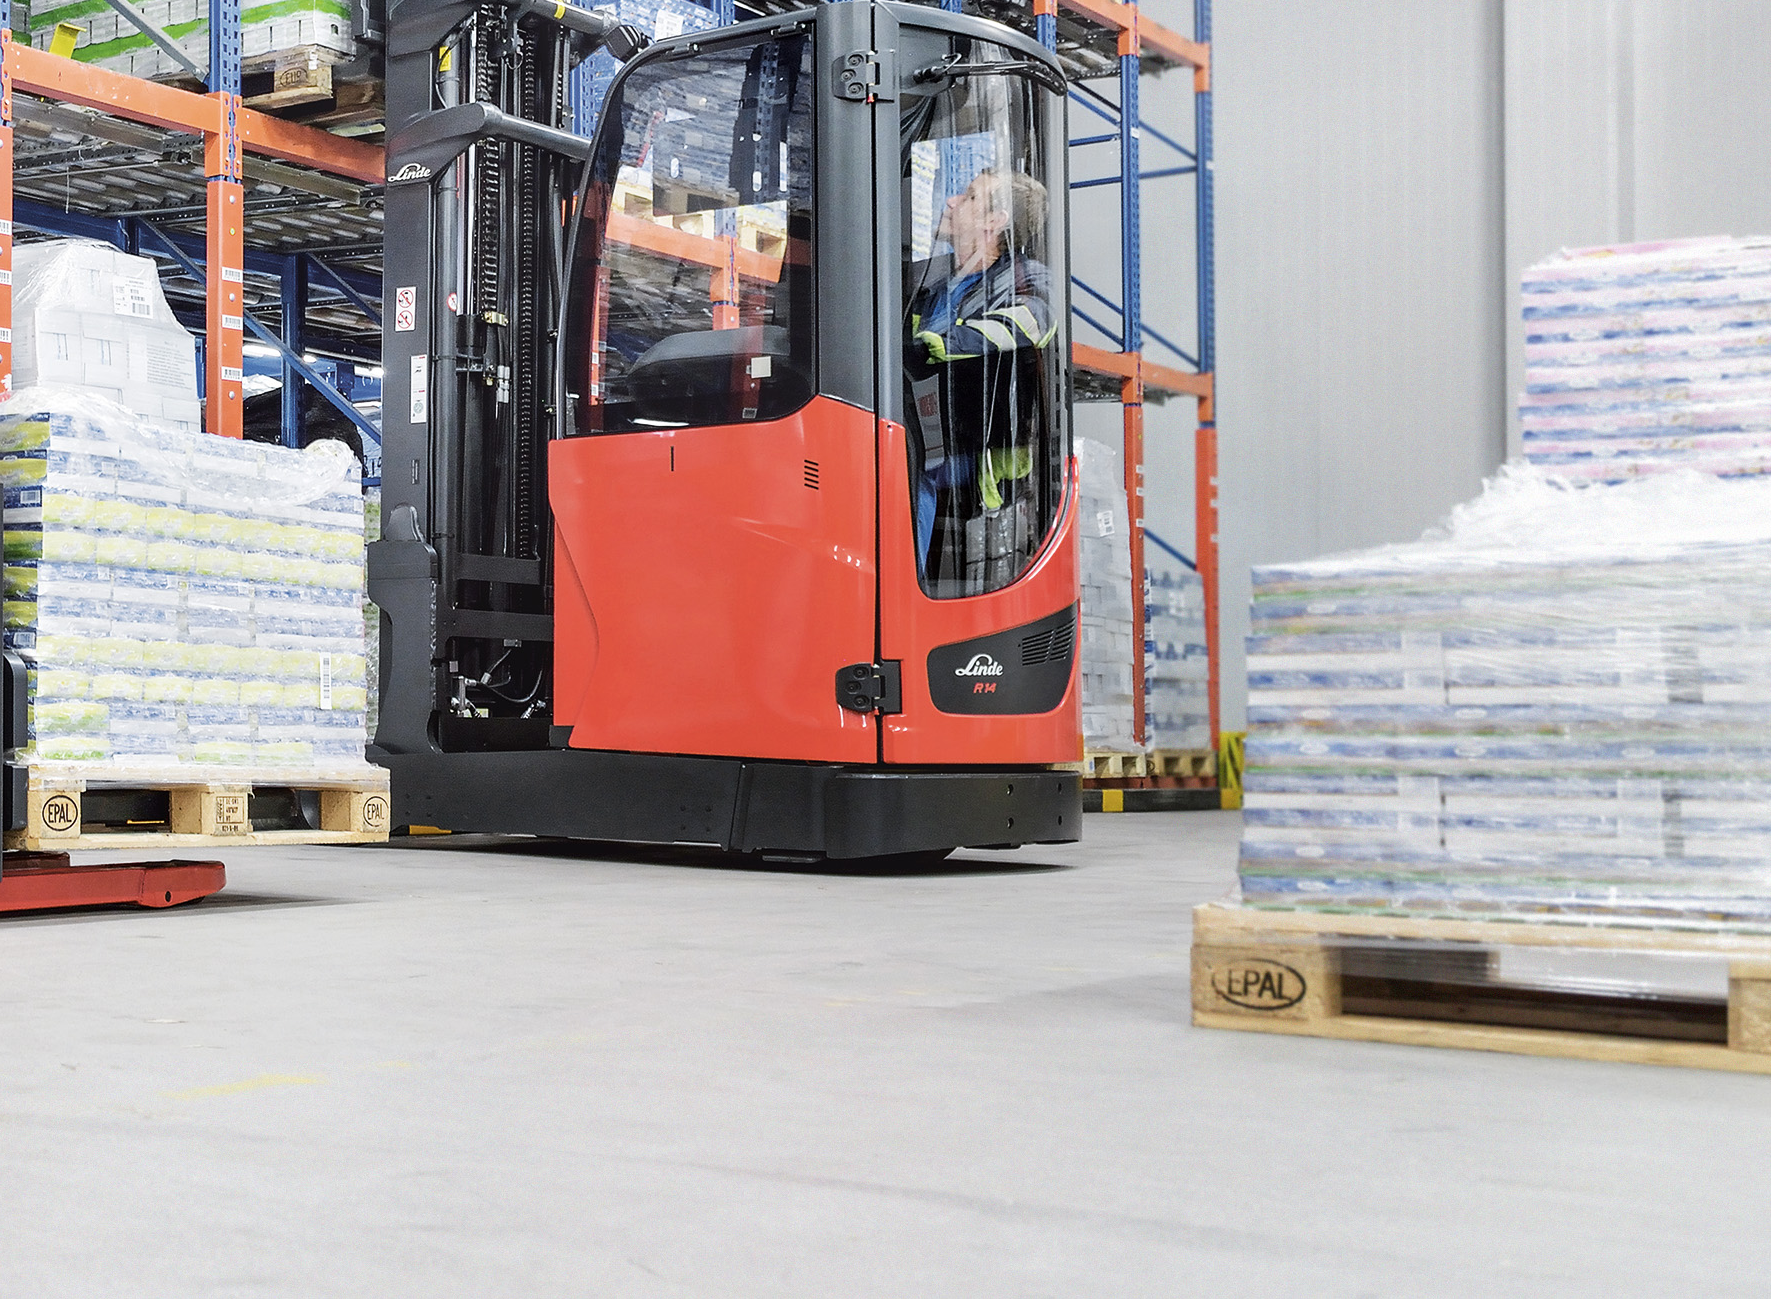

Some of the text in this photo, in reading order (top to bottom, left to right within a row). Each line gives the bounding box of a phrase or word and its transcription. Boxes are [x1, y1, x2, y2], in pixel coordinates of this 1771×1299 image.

[387, 162, 431, 182] Linde
[954, 653, 1004, 676] Linde
[973, 682, 997, 694] R14
[48, 803, 72, 823] EPAL
[367, 803, 385, 820] EPAL
[1227, 968, 1292, 1001] EPAL
